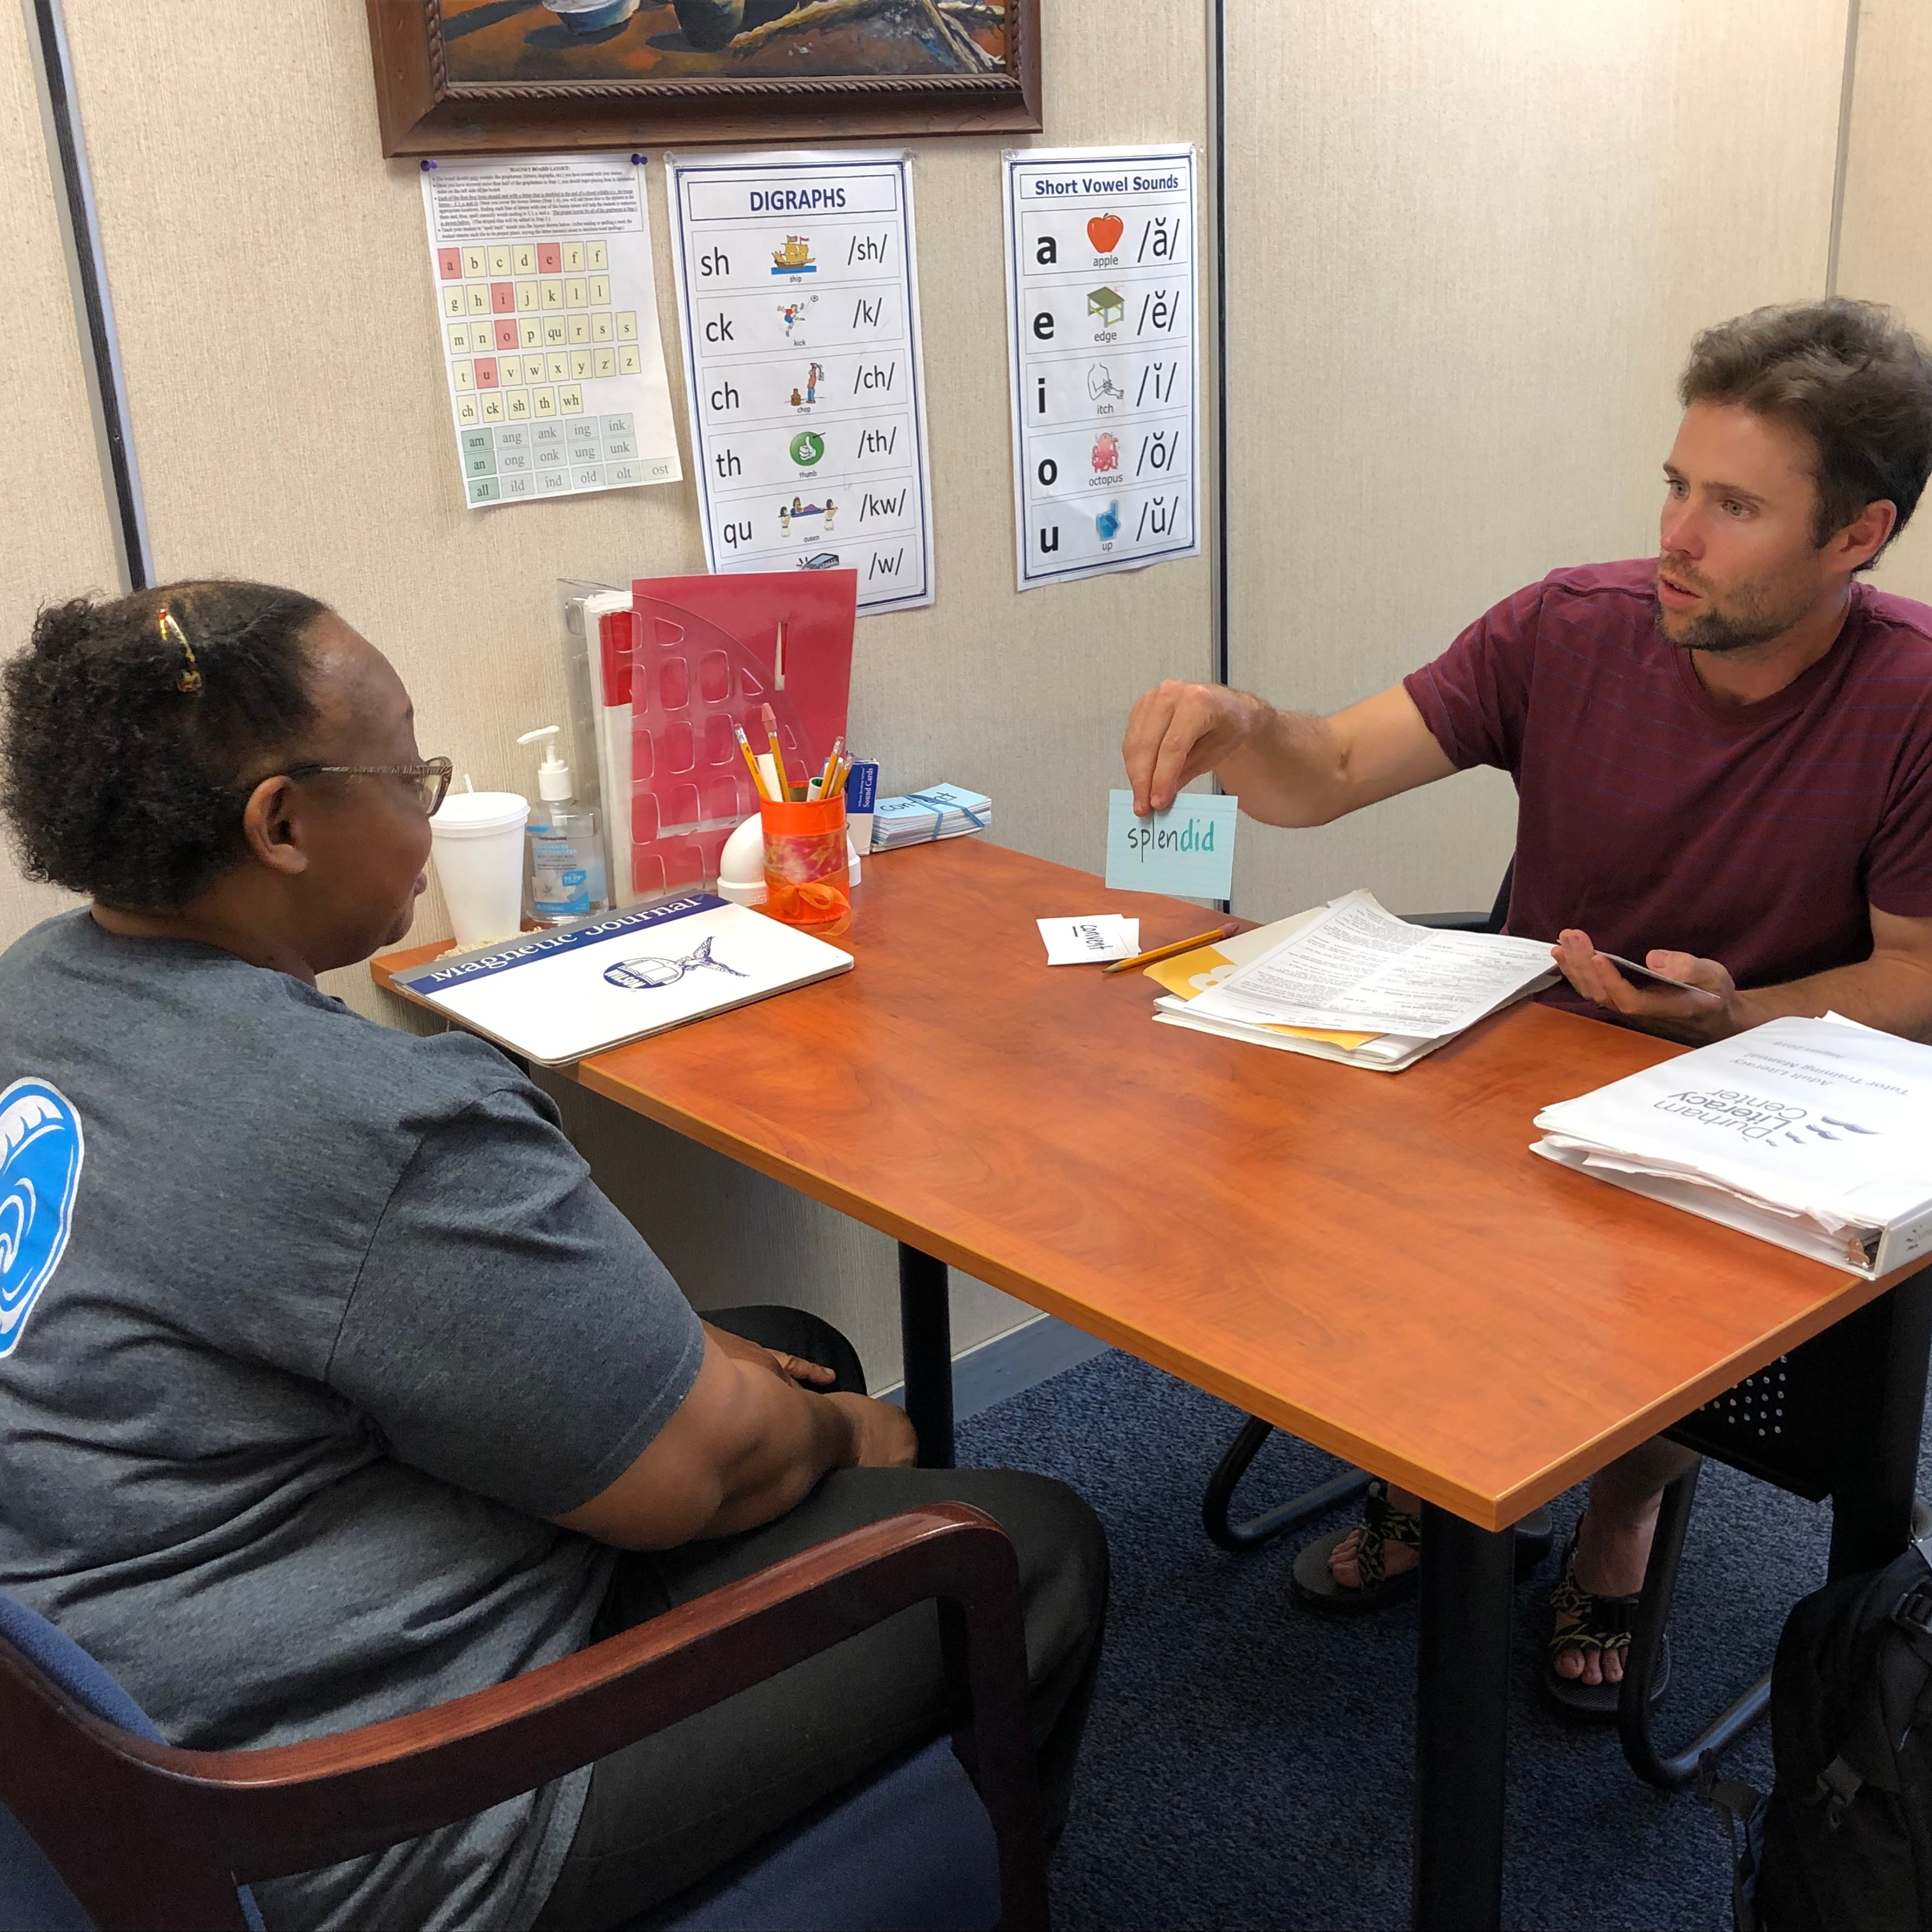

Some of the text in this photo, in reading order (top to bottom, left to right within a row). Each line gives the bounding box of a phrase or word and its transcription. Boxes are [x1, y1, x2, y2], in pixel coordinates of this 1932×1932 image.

[750, 187, 847, 211] DIGRAPHS
[1035, 174, 1178, 195] Short Vowel Sounds
[447, 250, 601, 270] a b c d e f f
[701, 234, 887, 283] sh ship /sh/
[1036, 217, 1180, 268] a apple /ă/
[452, 286, 602, 311] g h i j k l l
[1033, 289, 1179, 343] e edge /ĕ/
[454, 324, 629, 346] m n o p qu r s s
[705, 297, 882, 347] ck kick /k/
[461, 372, 466, 382] t
[483, 371, 490, 380] u
[507, 369, 514, 378] v
[530, 366, 539, 376] w
[555, 365, 562, 374] x
[578, 362, 585, 374] y
[602, 360, 608, 369] z
[711, 362, 894, 414] ch chop /ch/
[1038, 362, 1177, 415] i itch /ĭ/
[462, 395, 579, 417] ch ck sh th wh
[469, 419, 626, 447] am ang ank ing ink
[716, 449, 741, 478] th
[857, 426, 896, 459] /th/
[473, 441, 630, 470] an ong onk ung unk
[1038, 431, 1179, 487] o octopus /ŏ/
[477, 464, 669, 496] all ild ind old olt ost
[723, 488, 907, 549] qu queen /kw/
[1040, 496, 1179, 553] u up /ŭ/
[869, 548, 904, 580] /w/
[862, 767, 873, 808] Sound Cards
[1128, 818, 1215, 863] splendid
[431, 898, 702, 982] Magnetic Journal
[604, 969, 647, 988] WILSON
[1729, 1058, 1832, 1087] Adult Literacy
[1744, 1052, 1910, 1096] Tutor Training Manual
[1653, 1100, 1773, 1140] Durham
[1667, 1091, 1791, 1130] Literacy
[1705, 1088, 1807, 1121] Center
